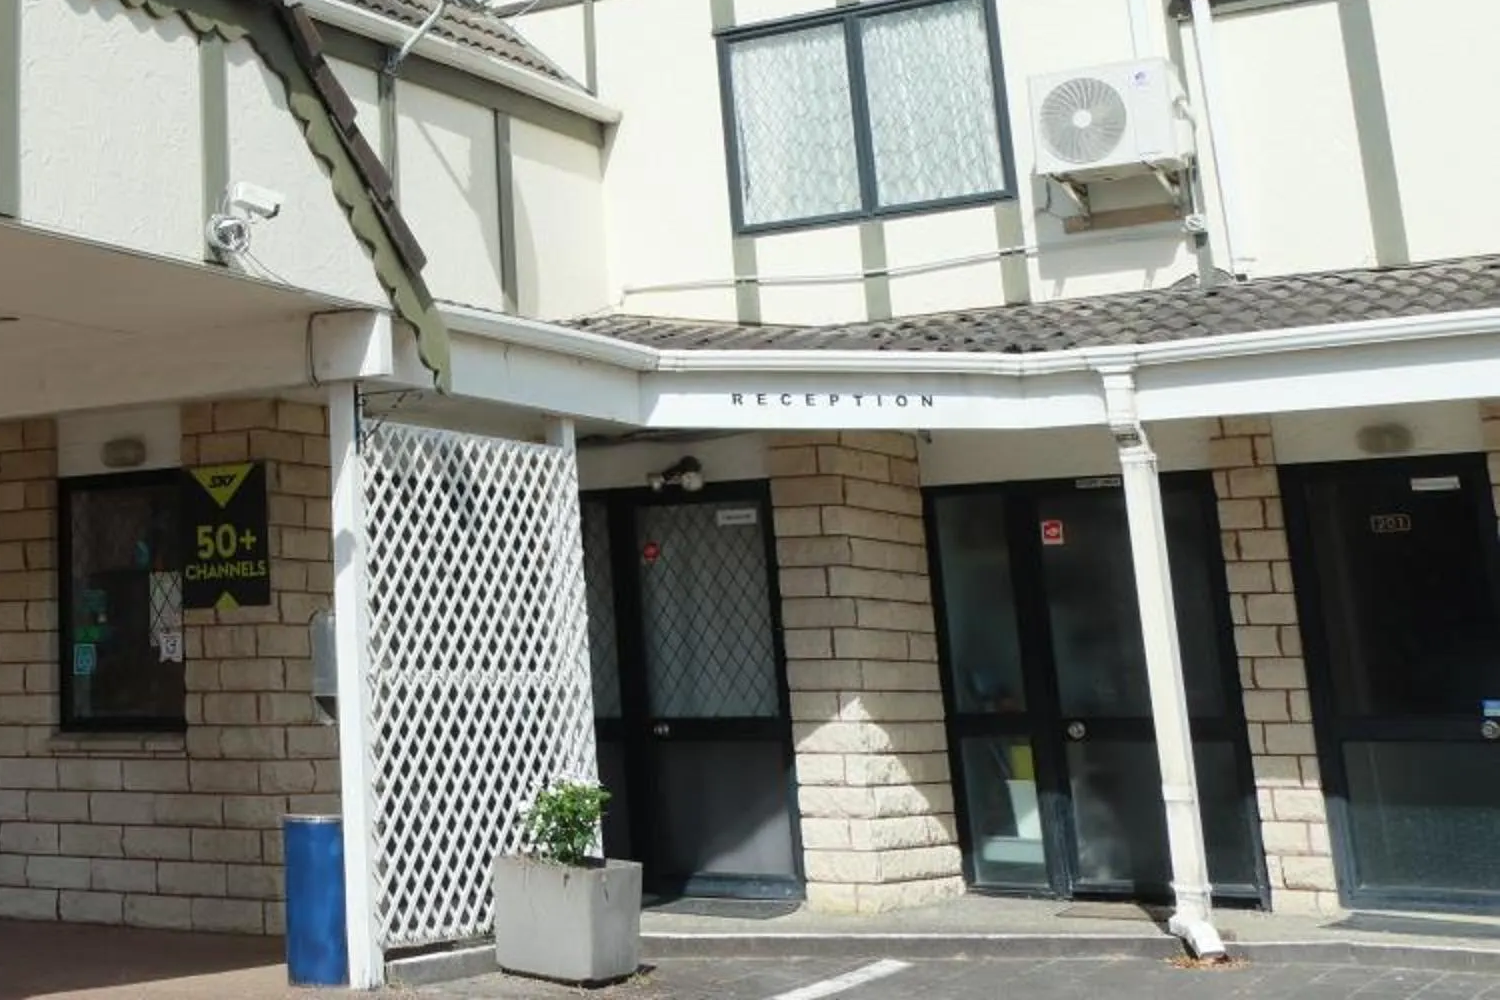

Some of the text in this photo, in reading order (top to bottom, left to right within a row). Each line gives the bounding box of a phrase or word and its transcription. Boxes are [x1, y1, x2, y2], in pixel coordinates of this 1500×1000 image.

[732, 392, 934, 407] RECEPTION
[197, 524, 257, 559] 50+
[185, 559, 267, 580] CHANNELS
